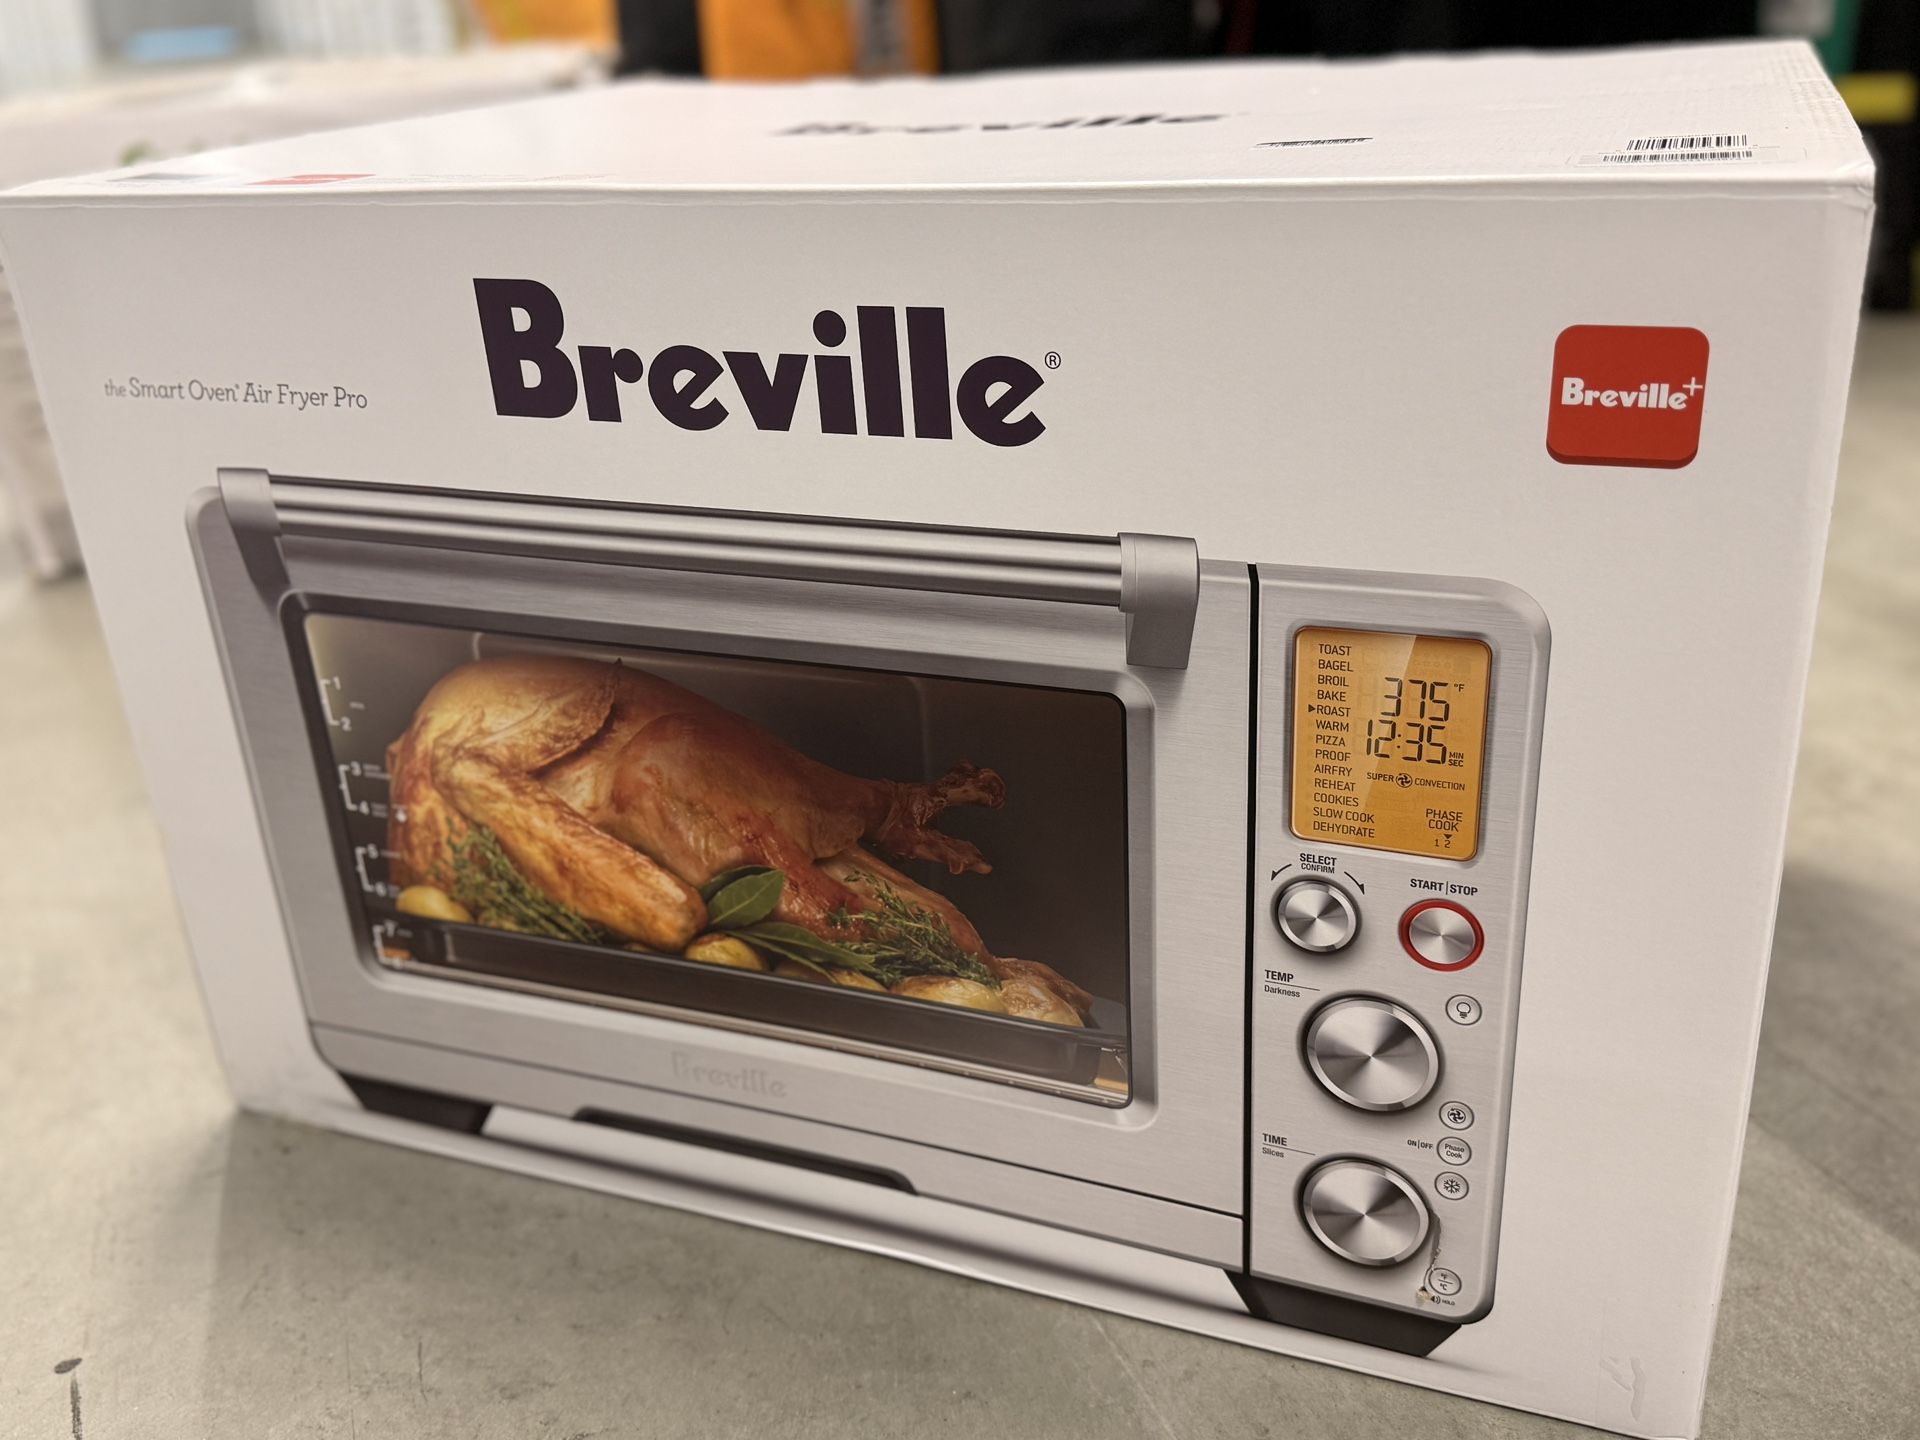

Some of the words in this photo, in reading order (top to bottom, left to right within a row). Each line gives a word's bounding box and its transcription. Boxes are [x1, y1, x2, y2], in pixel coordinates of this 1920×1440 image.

[104, 378, 126, 398] the
[128, 376, 185, 401] Smart
[242, 382, 272, 404] Air
[276, 383, 329, 411] Fryer
[333, 386, 368, 409] Pro
[1318, 643, 1352, 656] TOAST
[1318, 659, 1354, 672] BAGEL
[1317, 674, 1349, 687] BROIL
[1317, 689, 1347, 702] BAKE
[1381, 676, 1450, 722] 375
[1316, 704, 1351, 717] ROAST
[1315, 719, 1350, 733] WARM
[1315, 734, 1346, 747] PIZZA
[1366, 719, 1448, 765] 12:35
[1315, 749, 1351, 762] PROOF
[1449, 752, 1465, 760] MIN
[1314, 764, 1353, 777] AIRFRY
[1448, 760, 1465, 768] SEC
[1314, 778, 1356, 792] REHEAT
[1366, 772, 1395, 783] SUPER
[1414, 777, 1466, 791] CONVECTION
[1313, 792, 1360, 807] COOKIES
[1313, 806, 1343, 819] SLOW
[1345, 811, 1375, 824] COOK
[1425, 808, 1463, 823] PHASE
[1313, 821, 1375, 838] DEHYDRATE
[1428, 818, 1459, 832] COOK
[1444, 839, 1451, 849] 2
[1299, 852, 1337, 867] SELECT
[1300, 862, 1335, 874] CONFIRM
[1264, 969, 1295, 983] TEMP
[1264, 984, 1301, 998] Darkness
[1262, 1132, 1288, 1147] TIME
[1262, 1147, 1285, 1158] Slices
[1444, 1143, 1465, 1153] Phase
[1445, 1150, 1463, 1159] Cook
